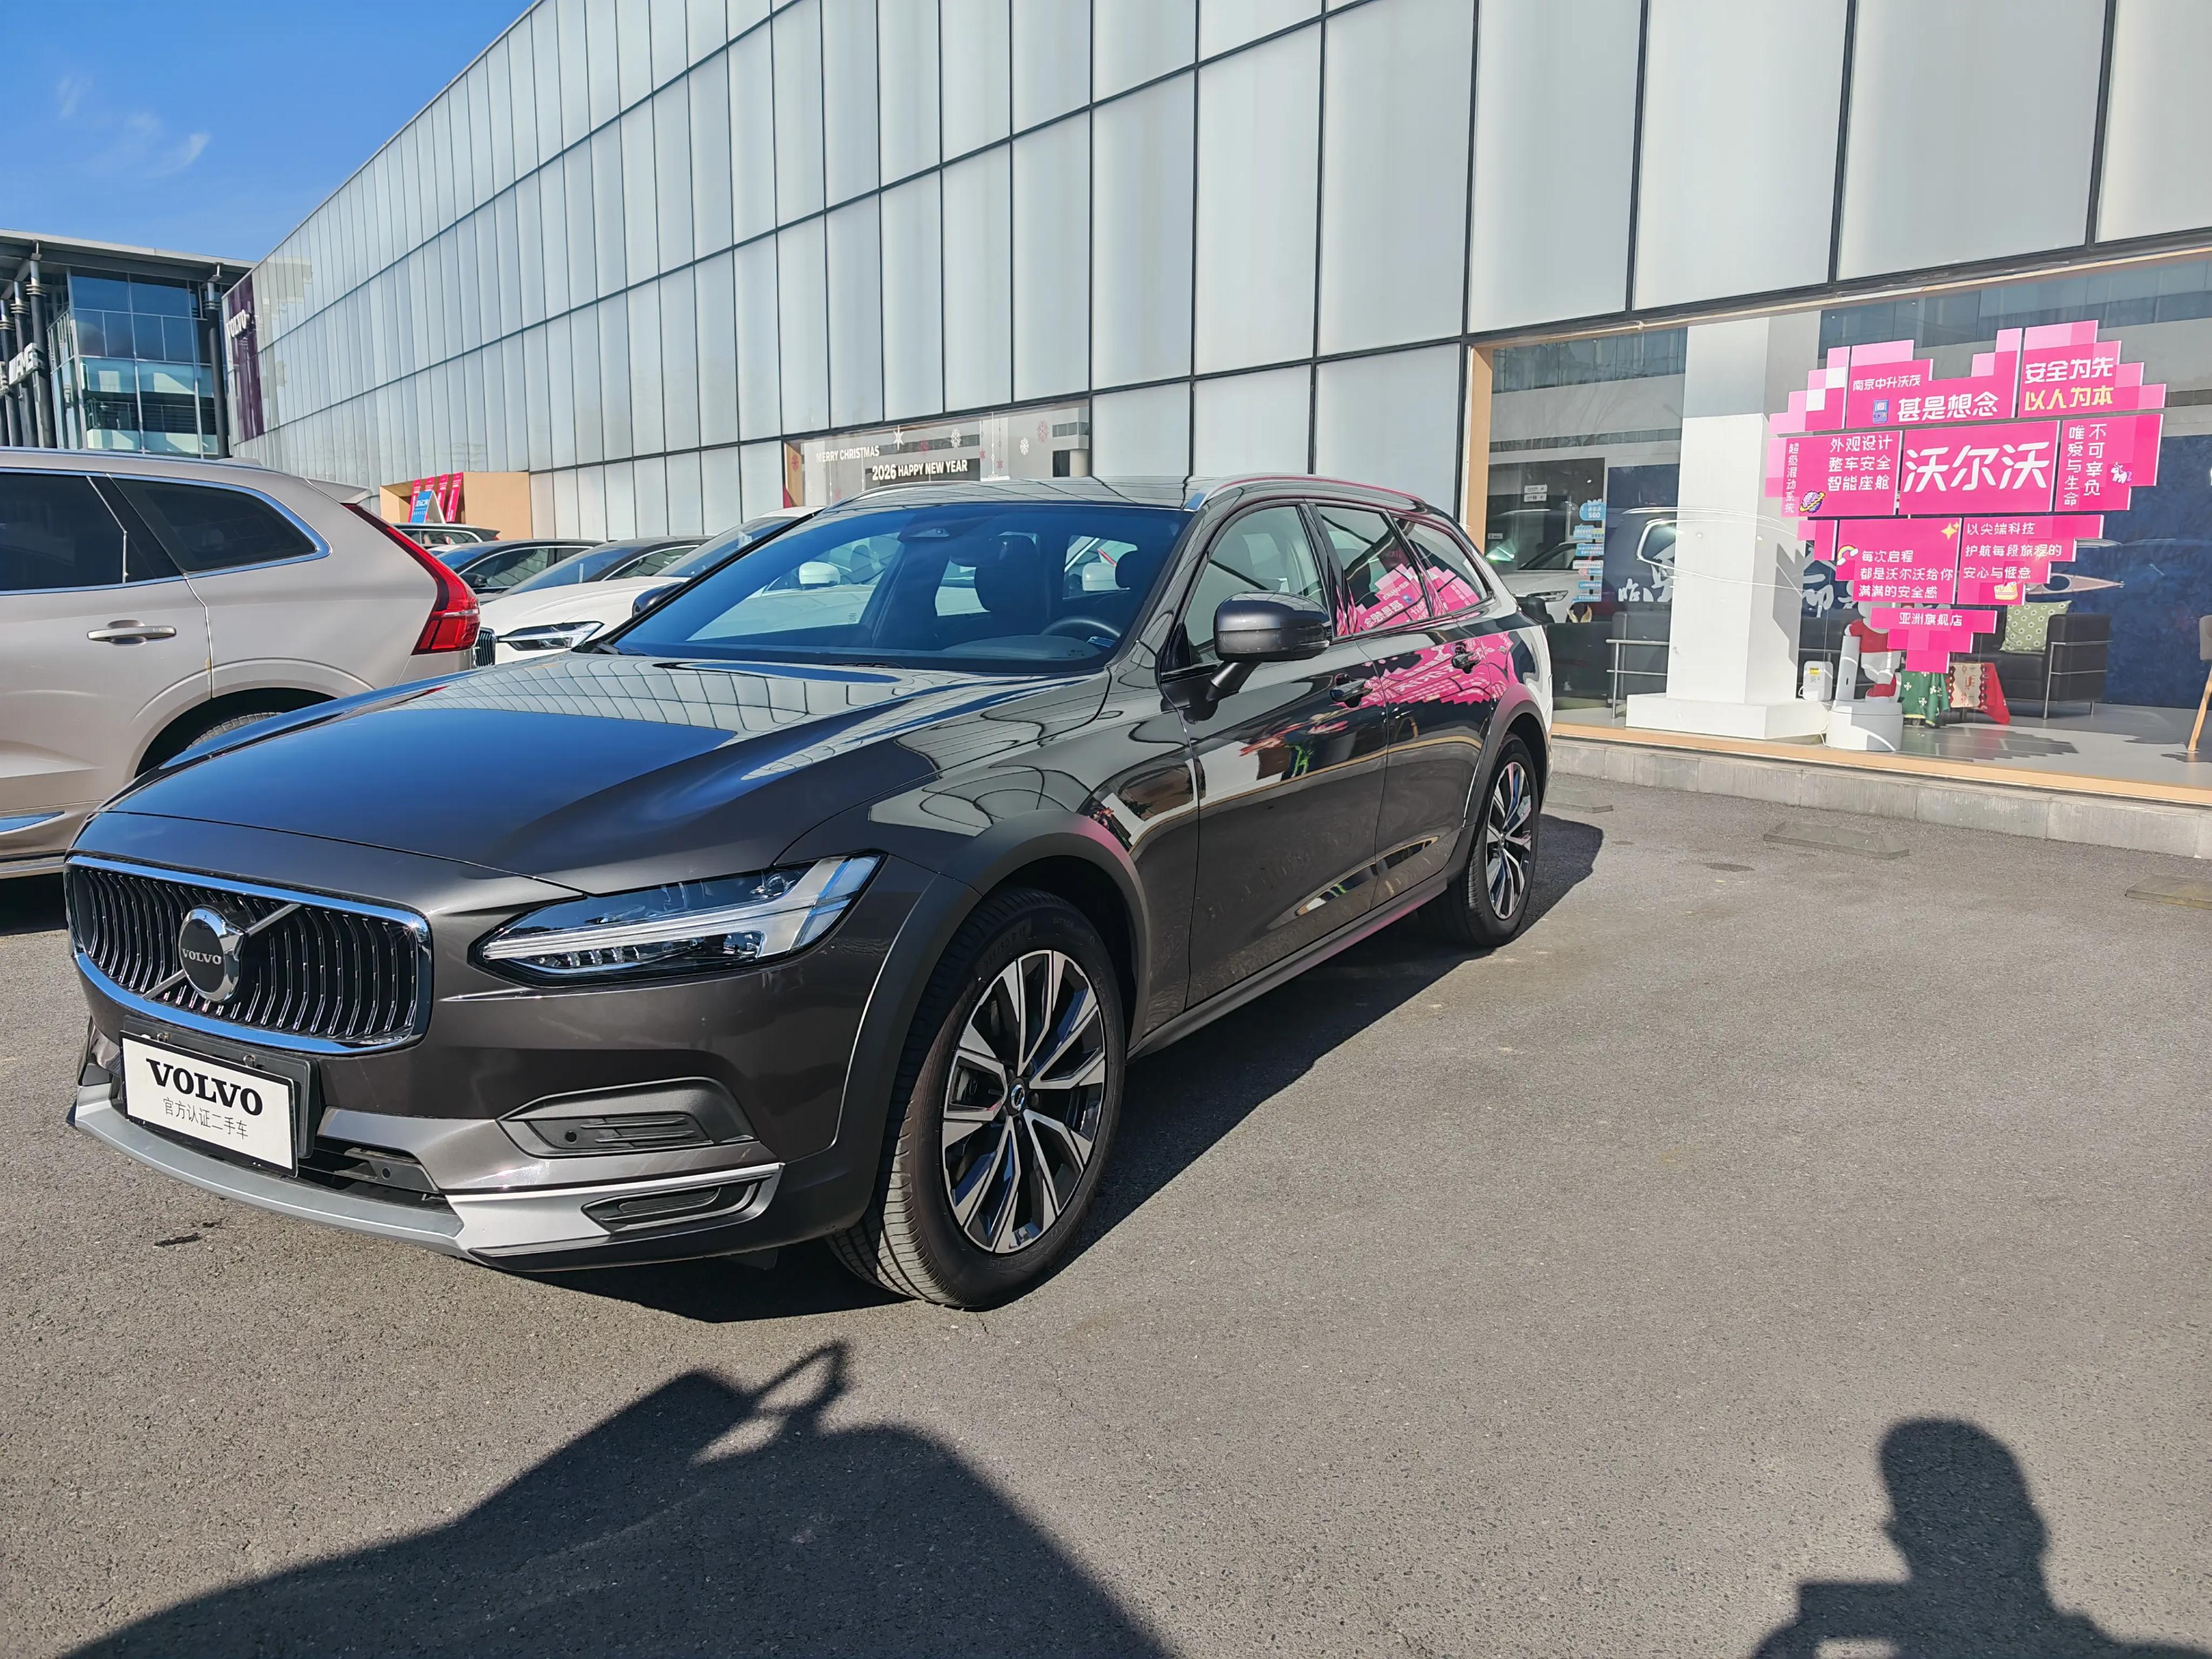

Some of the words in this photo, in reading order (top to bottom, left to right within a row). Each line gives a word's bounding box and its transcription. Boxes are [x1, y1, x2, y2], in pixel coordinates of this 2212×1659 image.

[226, 309, 247, 340] VOLVO
[2024, 357, 2114, 384] 安全为先
[1853, 374, 1922, 392] 南京中升沃茂
[1897, 391, 2000, 422] 甚是想念
[2024, 385, 2114, 411] 以人为本
[1830, 434, 1893, 453] 外观设计
[816, 450, 838, 463] MERRY
[840, 445, 880, 460] CHRISTMAS
[1828, 454, 1892, 473] 整车安全
[872, 464, 896, 480] 2026
[898, 463, 923, 477] HAPPY
[925, 463, 945, 475] NEW
[945, 460, 968, 473] YEAR
[1903, 441, 2051, 494] 沃尔沃
[2063, 424, 2085, 506] 唯爱与生命
[1784, 442, 1800, 514] 超级混动系统
[1827, 474, 1890, 492] 智能座舱
[1967, 522, 2036, 536] 以尖端科技
[1861, 550, 1914, 563] 每次启程
[1965, 544, 2062, 557] 护航每段旅程的
[1860, 567, 1953, 581] 都是沃尔沃给你
[1963, 566, 2031, 579] 安心与惬意
[1858, 584, 1938, 599] 满满的安全感
[1899, 612, 1963, 627] 亚洲旗舰店
[181, 948, 222, 966] VOLVO
[146, 1058, 263, 1116] VOLVO
[163, 1097, 249, 1140] 官方认证二手车
